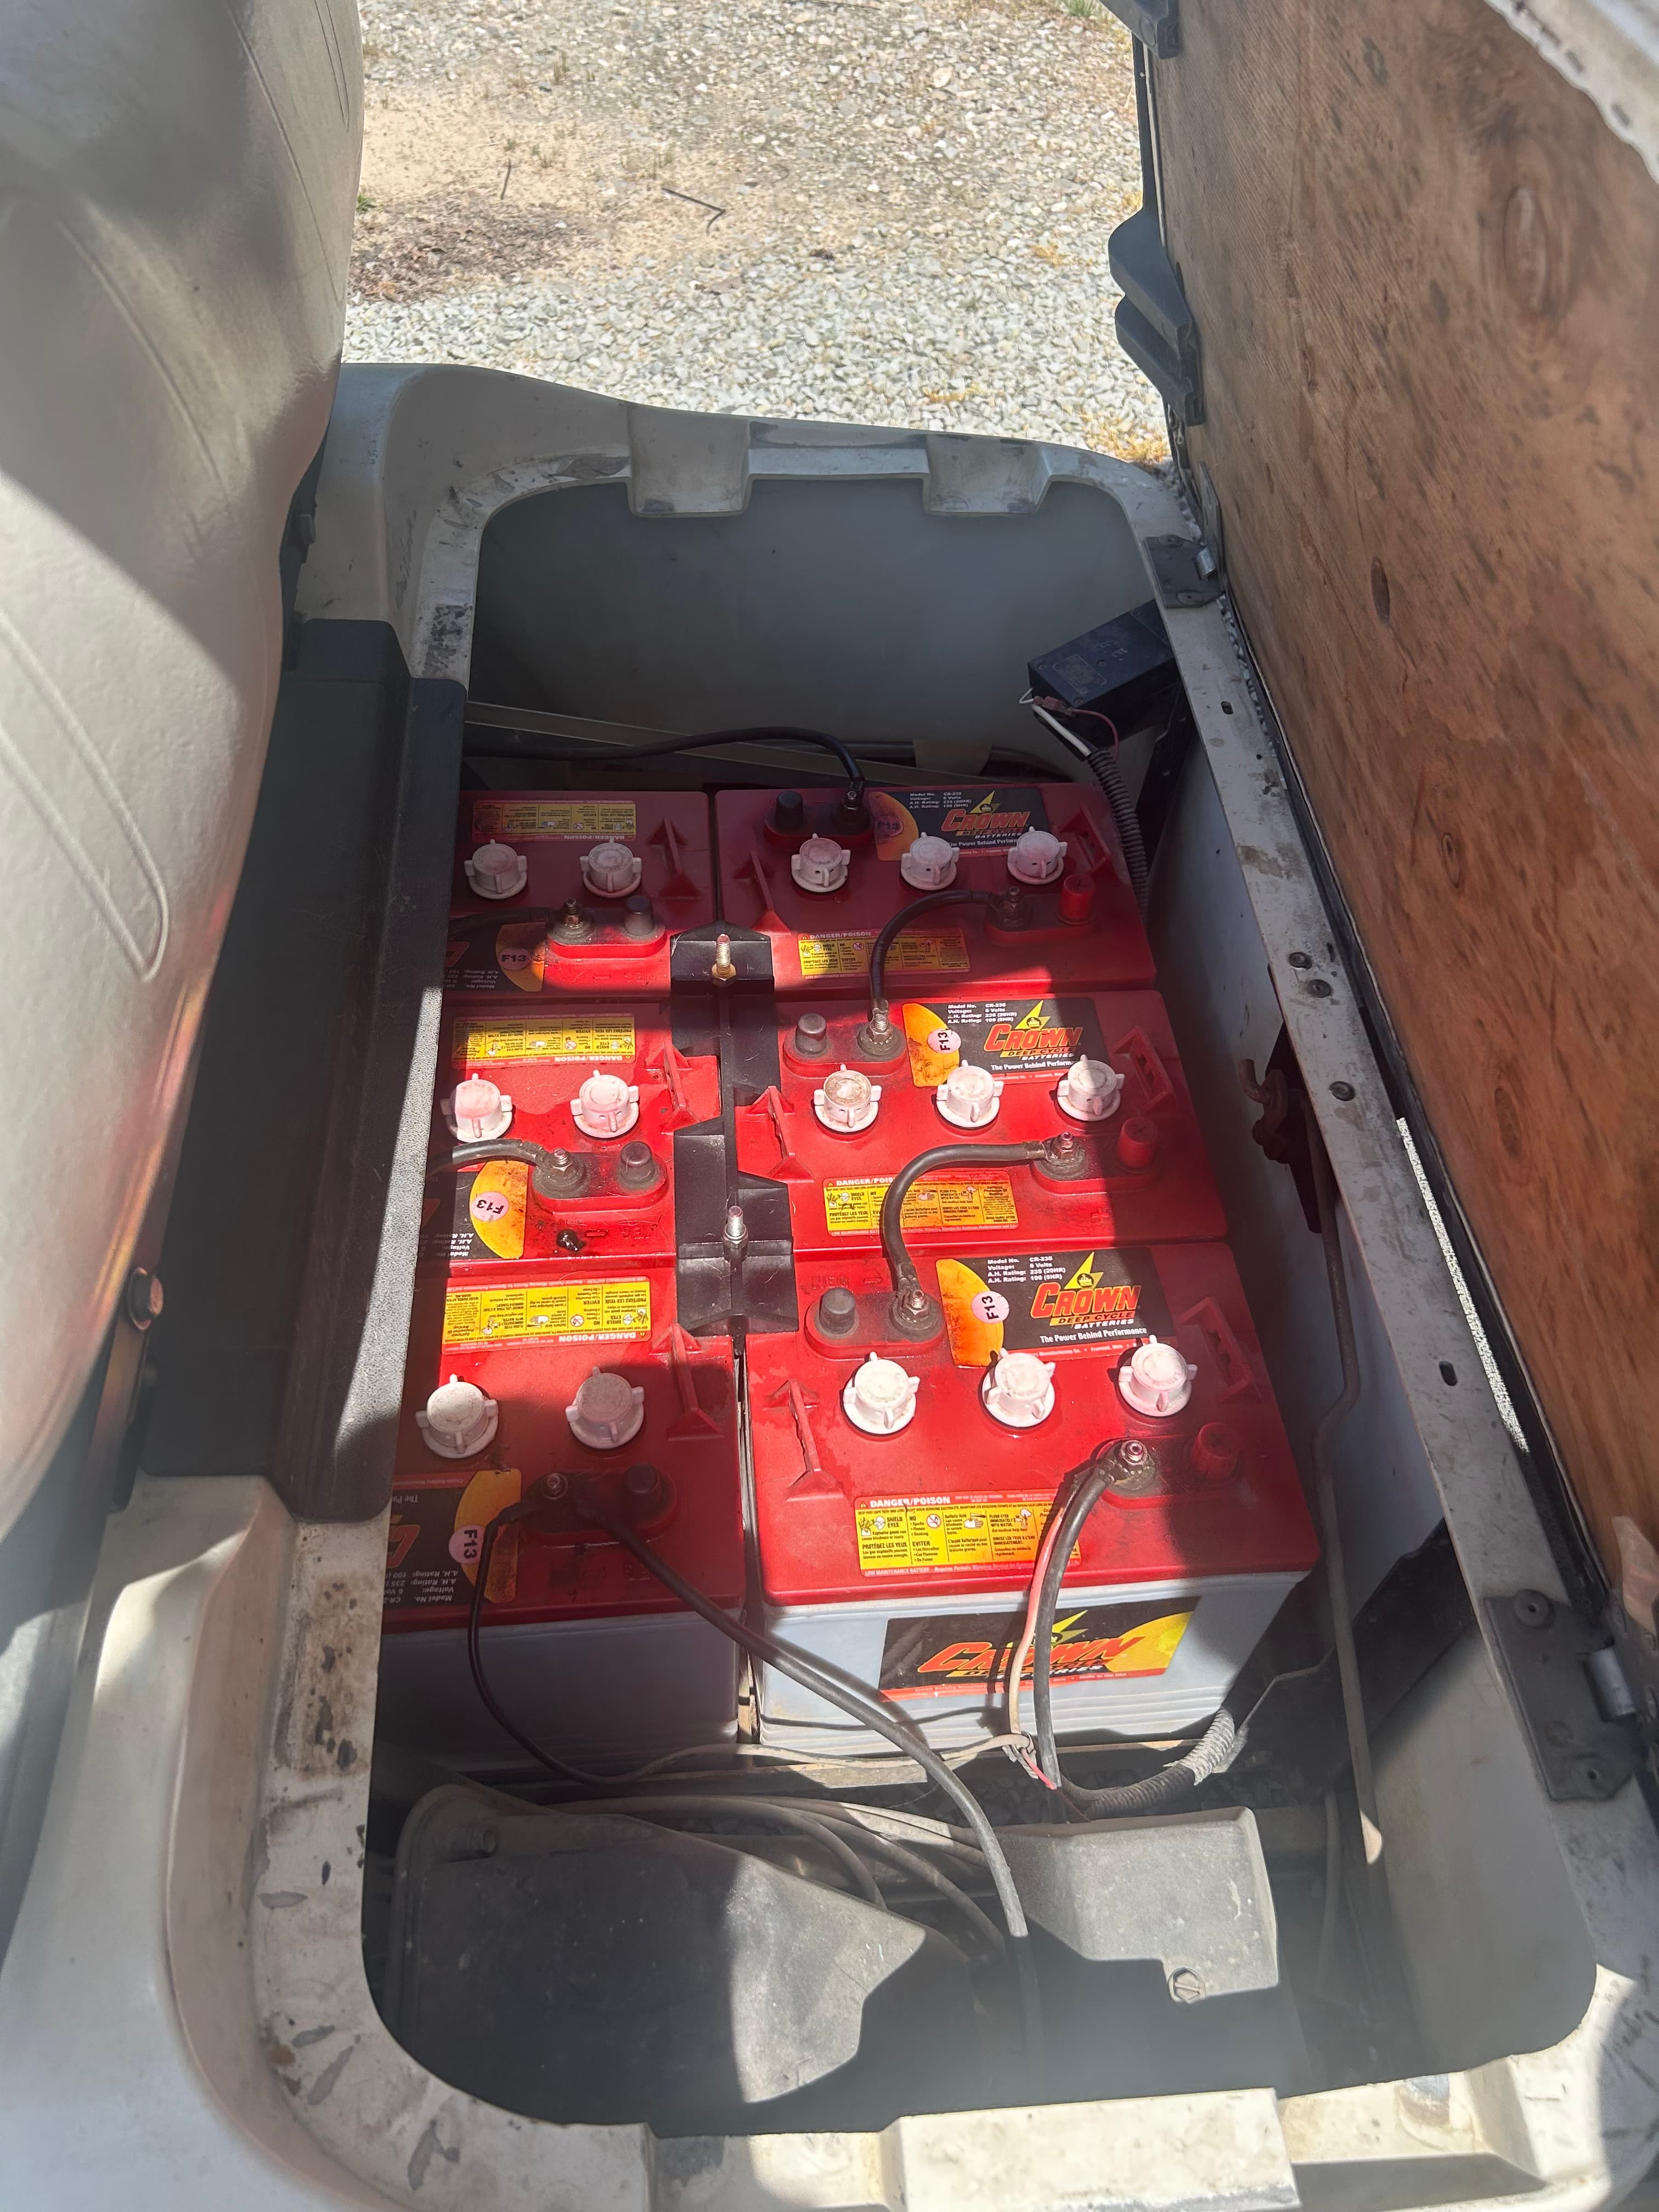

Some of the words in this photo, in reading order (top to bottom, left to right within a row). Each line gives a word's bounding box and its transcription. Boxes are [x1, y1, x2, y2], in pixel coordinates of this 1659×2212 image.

[941, 809, 1030, 831] CROWN
[938, 1032, 950, 1051] F13
[984, 1023, 1083, 1052] CROWN
[836, 1177, 895, 1186] DANGER/POIS
[476, 1199, 505, 1214] F13
[981, 1296, 999, 1319] F13
[1030, 1282, 1142, 1318] CROWN
[1094, 1312, 1133, 1320] CYCLE
[1074, 1319, 1135, 1330] BATTERIES
[558, 1331, 636, 1342] DANGER/POISON
[1054, 1334, 1077, 1342] Power
[1078, 1331, 1102, 1340] Behind
[1103, 1328, 1147, 1338] Performance
[870, 1496, 950, 1508] DANGER/POISON
[464, 1529, 477, 1559] F13
